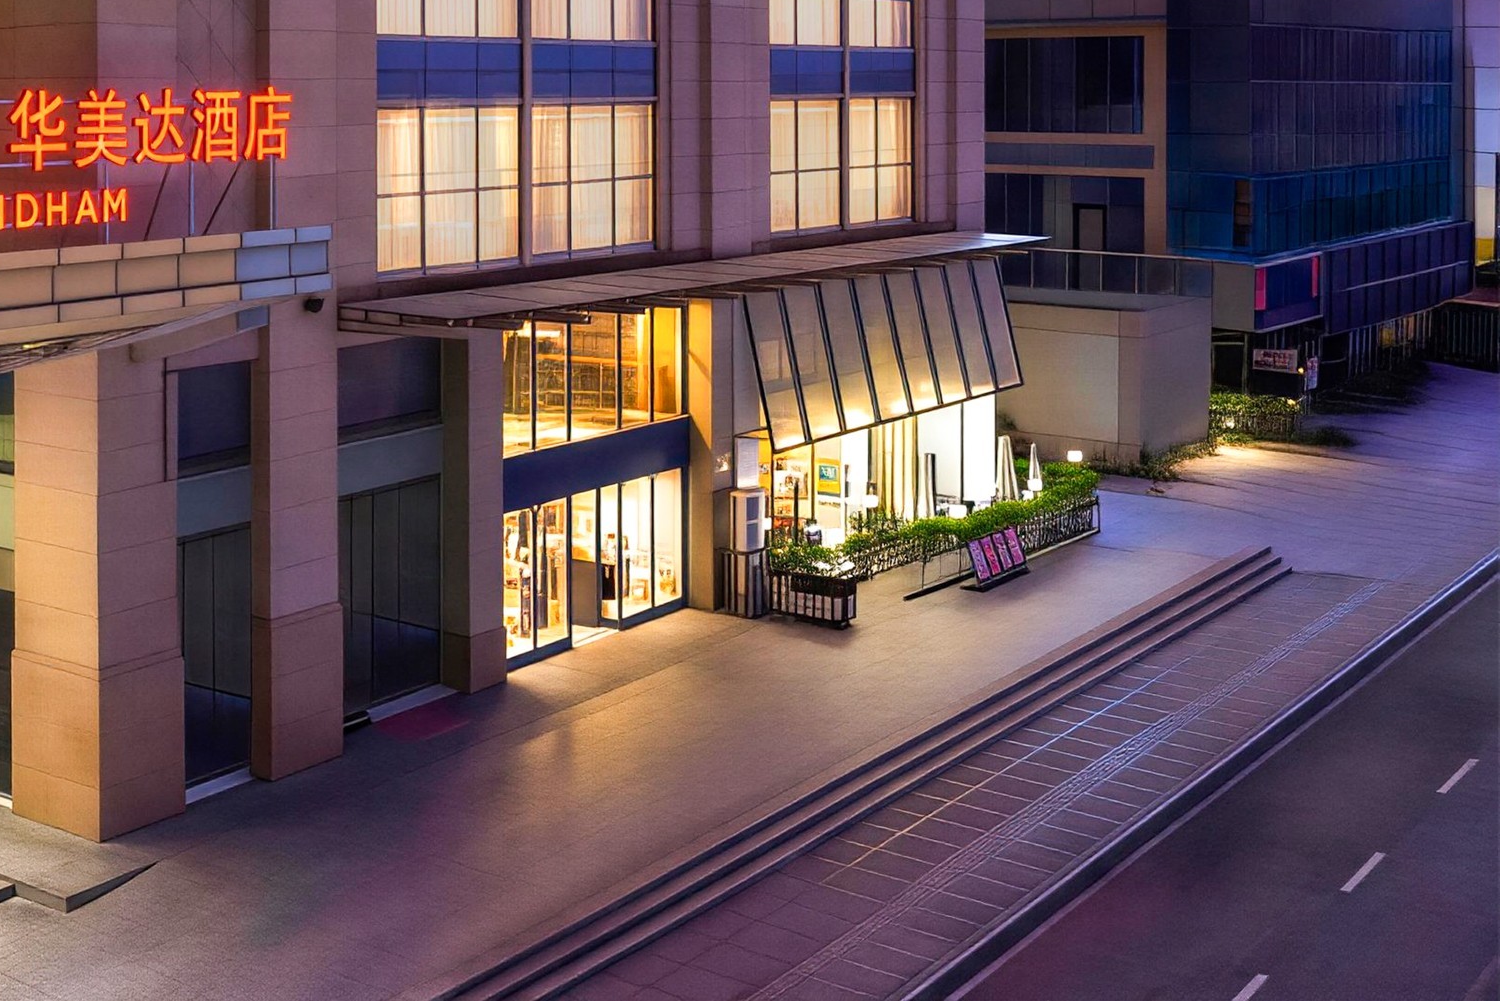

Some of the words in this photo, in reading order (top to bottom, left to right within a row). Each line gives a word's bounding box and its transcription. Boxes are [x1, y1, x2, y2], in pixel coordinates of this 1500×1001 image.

[8, 85, 293, 172] 华美达酒店
